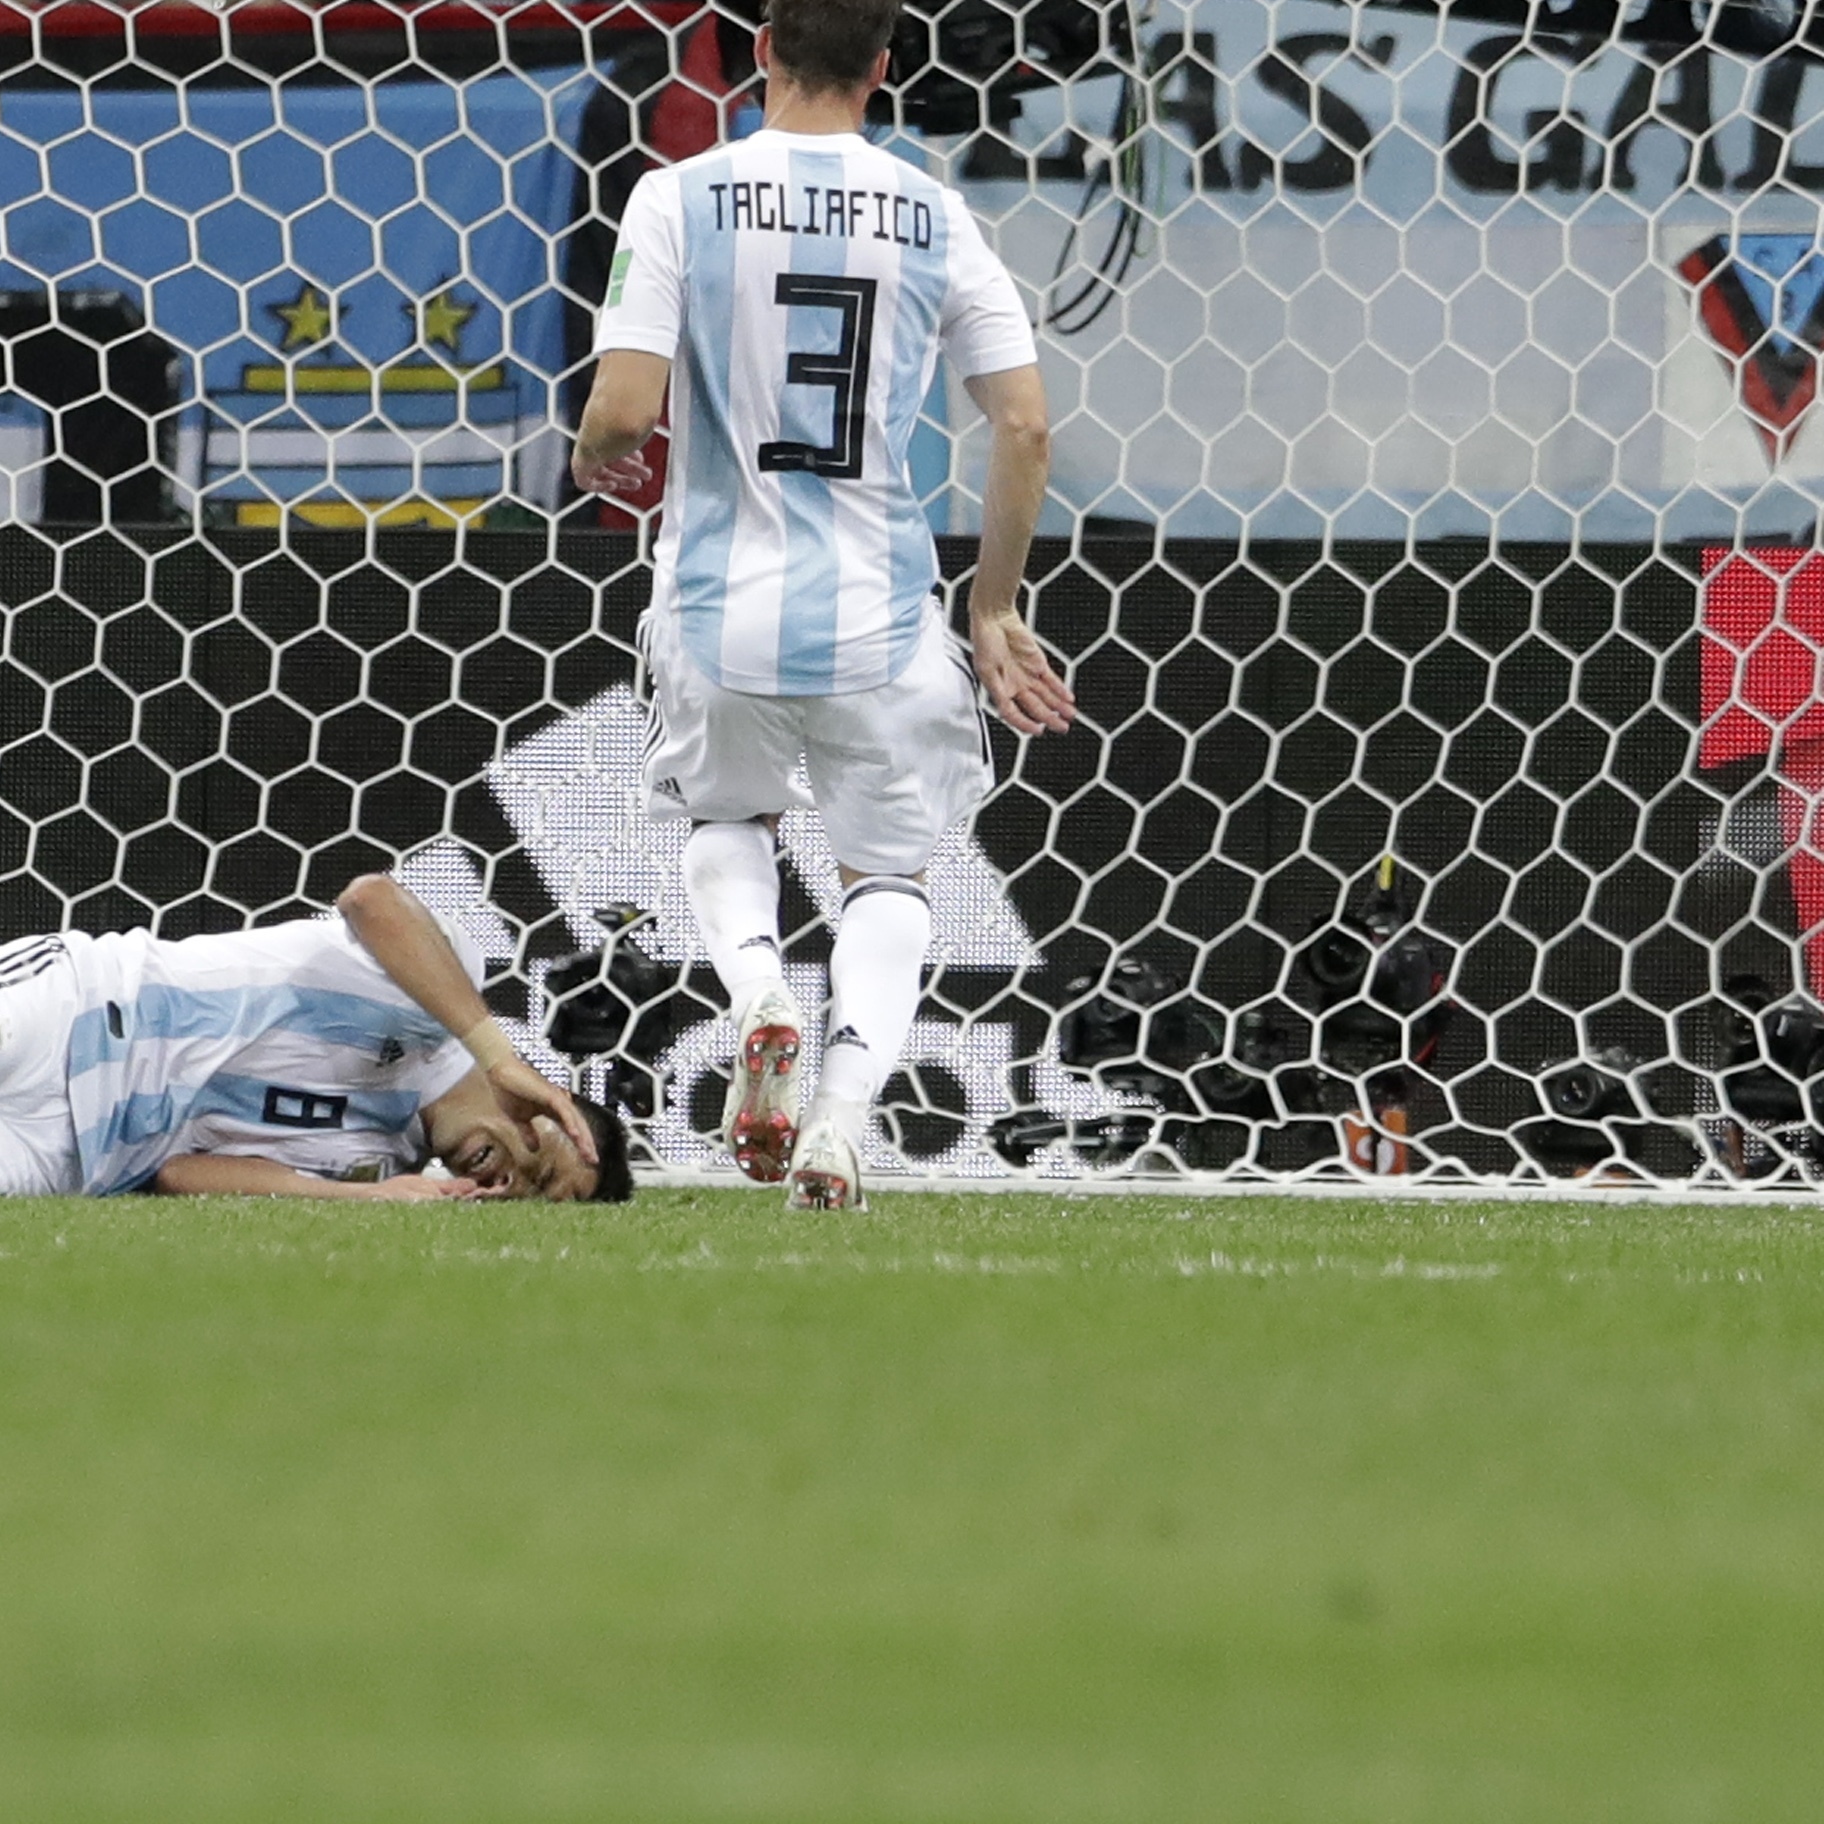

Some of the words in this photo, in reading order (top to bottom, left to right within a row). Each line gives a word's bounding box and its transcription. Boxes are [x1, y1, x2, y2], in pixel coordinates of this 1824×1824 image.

[708, 182, 933, 250] TAGLIAFICO
[757, 272, 879, 480] 3
[262, 1085, 348, 1129] 8
